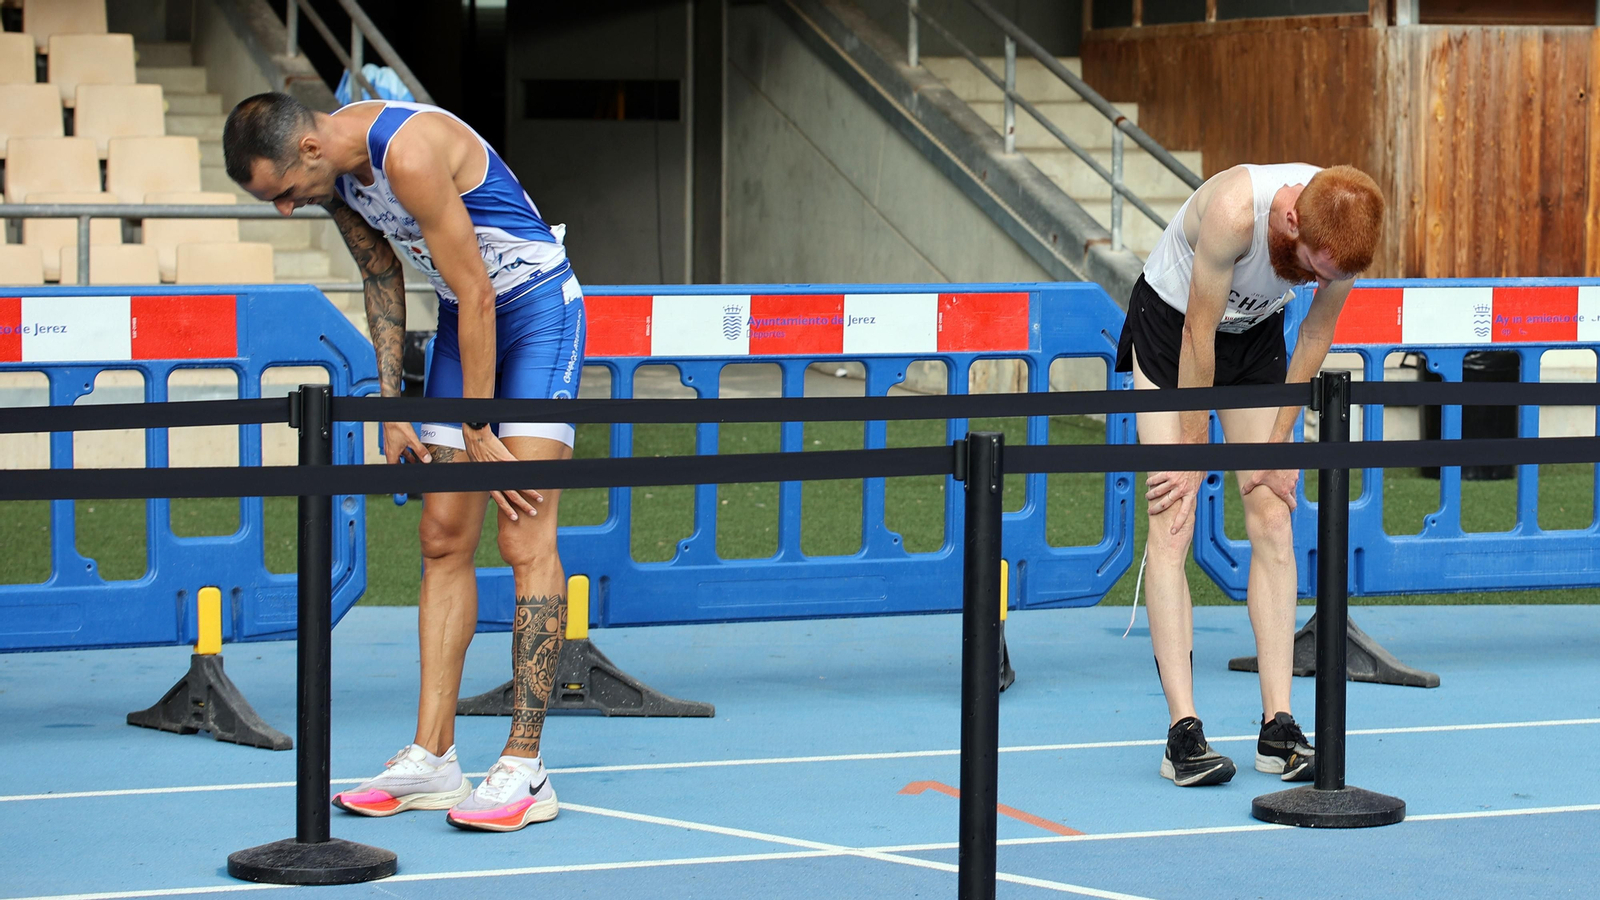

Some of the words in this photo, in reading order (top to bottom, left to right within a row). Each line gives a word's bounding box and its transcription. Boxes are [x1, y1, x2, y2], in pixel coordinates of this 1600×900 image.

[746, 315, 829, 328] Ayuntamiento
[831, 315, 844, 325] de
[847, 315, 876, 327] Jerez
[1572, 314, 1585, 322] de
[14, 324, 30, 334] de
[33, 323, 67, 336] Jerez
[746, 330, 786, 340] Deportes
